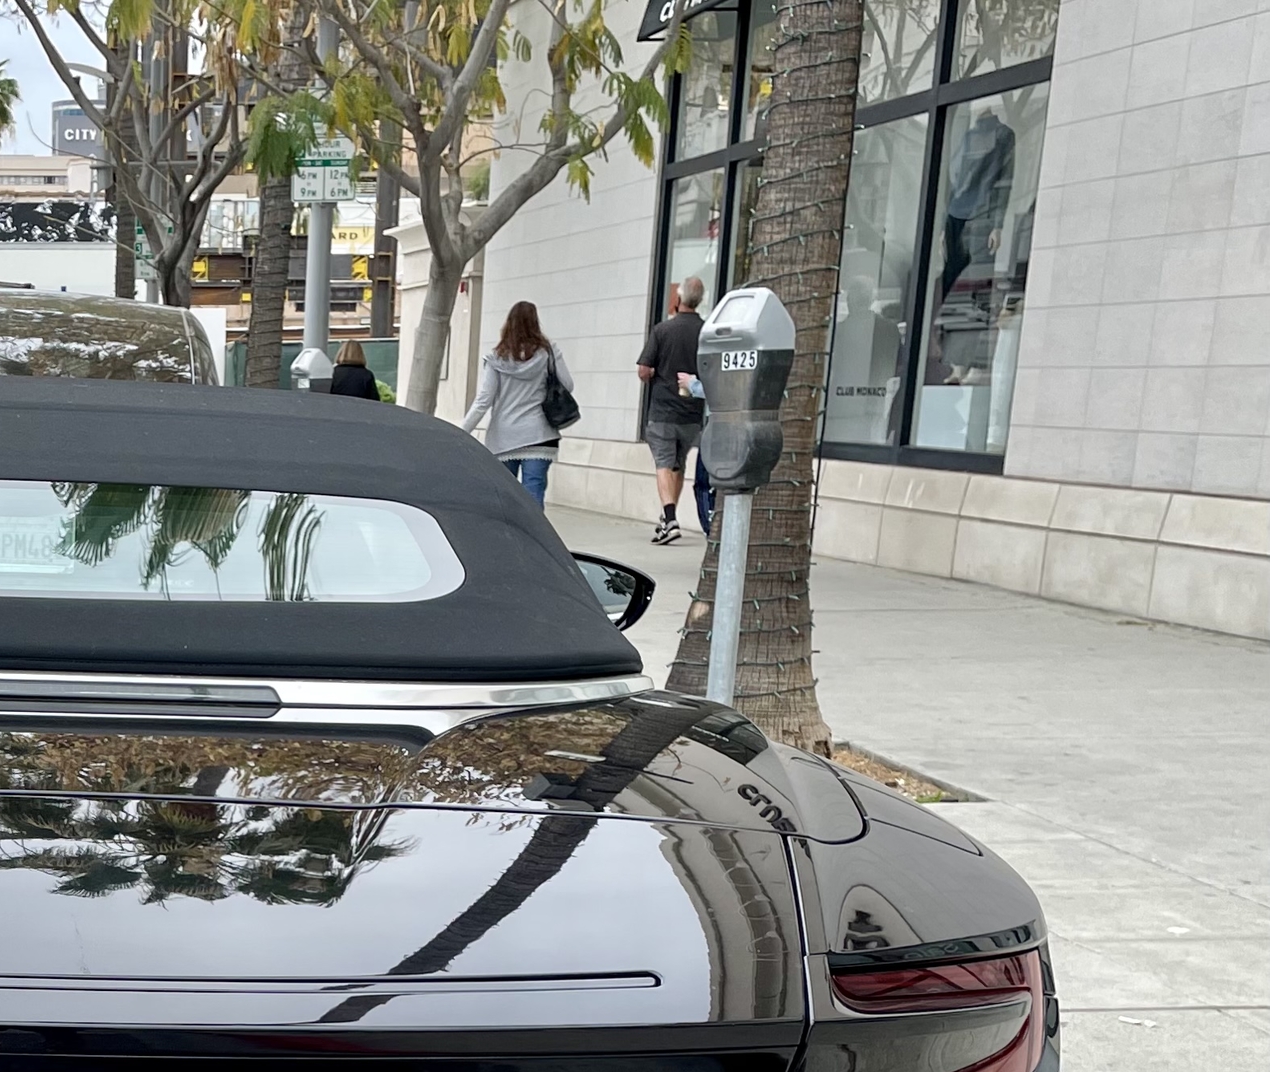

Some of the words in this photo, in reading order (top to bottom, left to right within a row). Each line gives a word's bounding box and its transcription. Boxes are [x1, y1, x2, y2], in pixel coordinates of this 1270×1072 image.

[64, 128, 96, 141] CITY
[330, 169, 339, 179] 12
[723, 352, 756, 369] 9425
